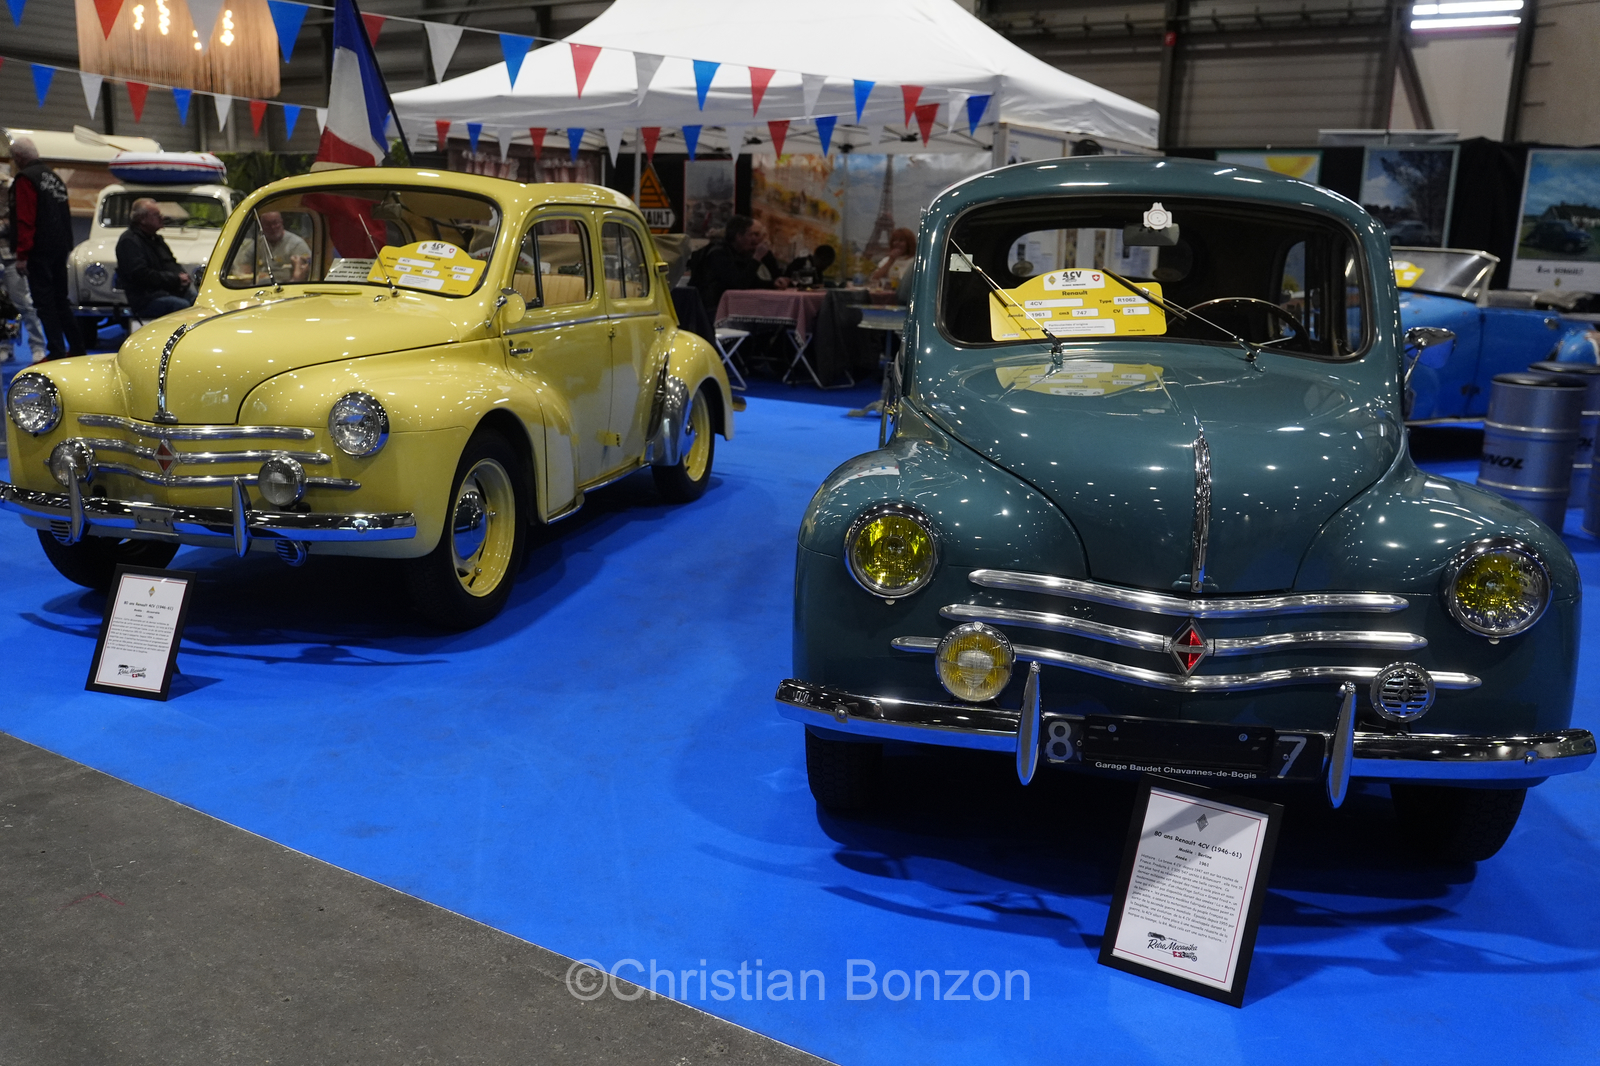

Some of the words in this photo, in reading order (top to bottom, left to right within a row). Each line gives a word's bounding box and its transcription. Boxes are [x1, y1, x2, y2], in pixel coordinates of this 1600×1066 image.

[1045, 721, 1073, 761] 8
[1277, 735, 1307, 779] 7
[1095, 762, 1128, 772] Garage
[1130, 764, 1162, 773] Baudet
[1164, 766, 1257, 780] Chavannes-de-Bogis
[1174, 836, 1196, 846] Renault
[1211, 845, 1242, 859] (1946-61)
[1148, 938, 1166, 950] Retro
[1164, 943, 1198, 951] Mecanika
